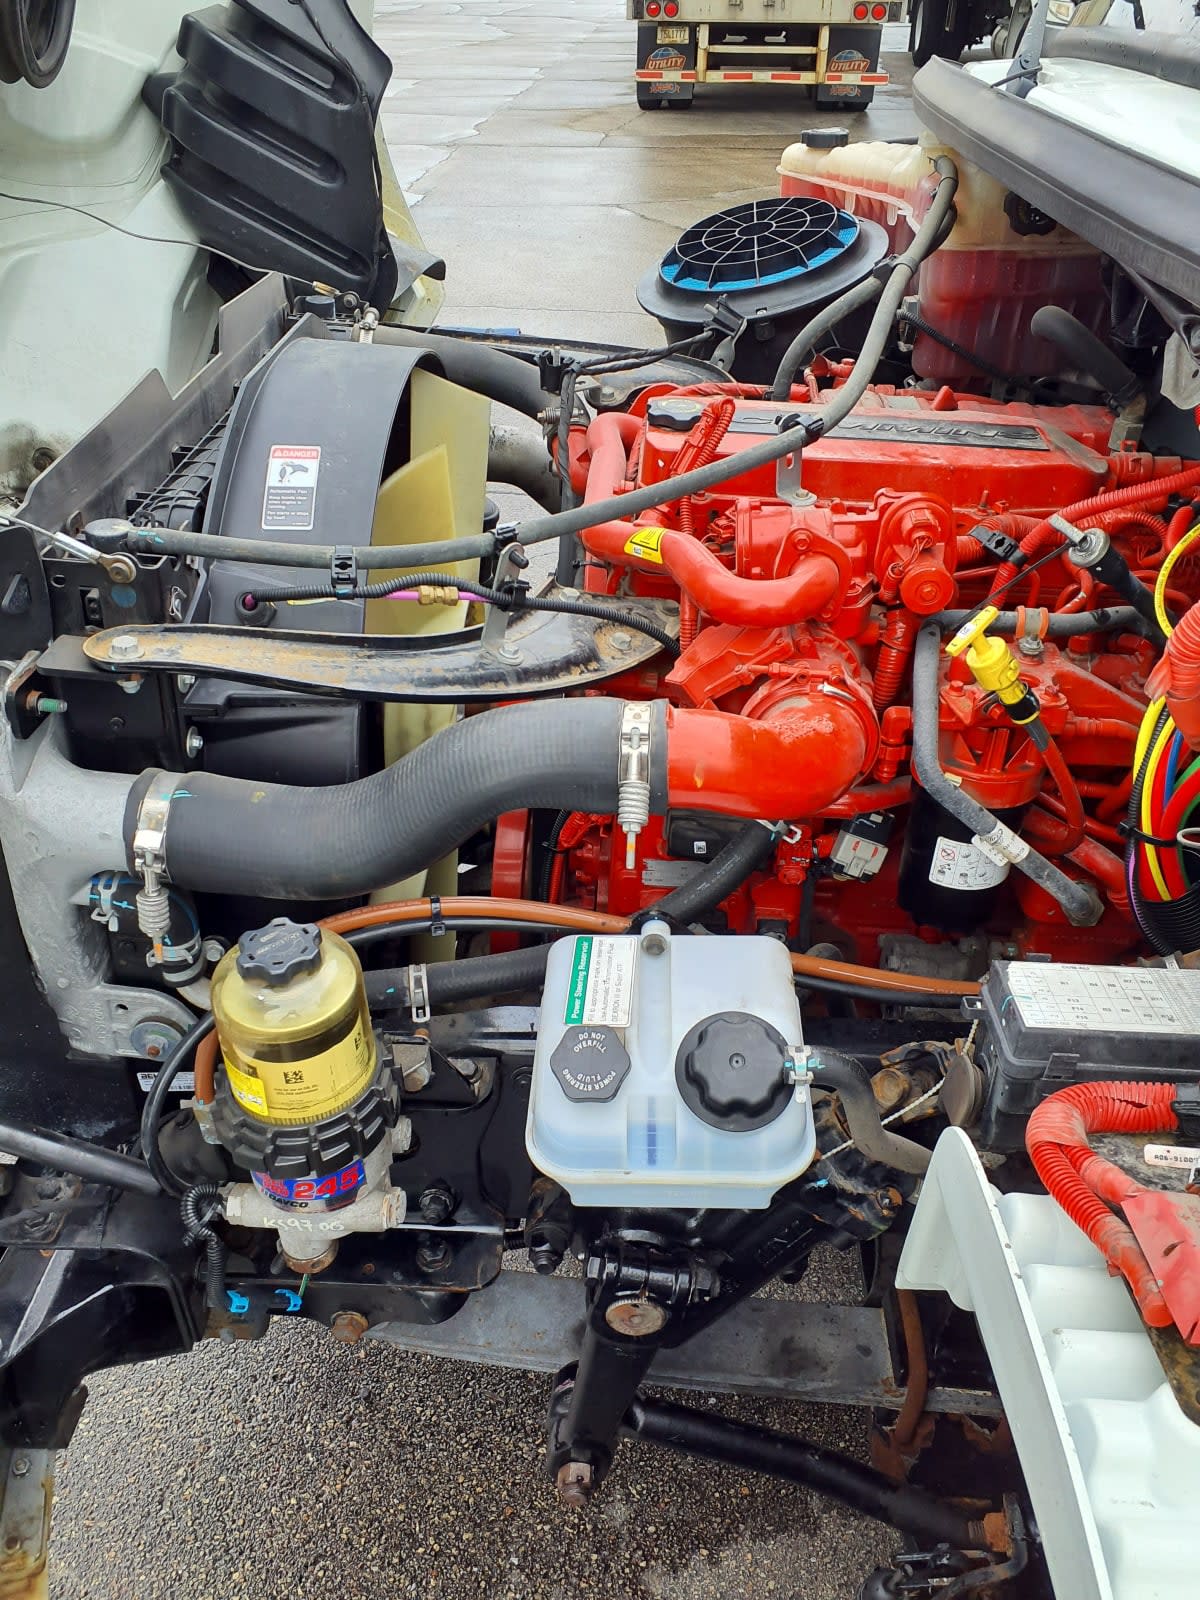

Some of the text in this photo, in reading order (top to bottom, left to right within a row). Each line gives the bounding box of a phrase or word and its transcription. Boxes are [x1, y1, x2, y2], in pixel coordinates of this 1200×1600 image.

[648, 58, 684, 69] UTILITY
[830, 61, 867, 71] UTILITY
[284, 450, 317, 458] DANGER
[571, 941, 589, 1019] Power Steering Reservoir
[578, 1032, 606, 1041] DO NOT
[573, 1040, 607, 1053] OVERFILL
[562, 1068, 616, 1092] POWER STEERING
[577, 1073, 602, 1082] FLUID
[293, 1166, 359, 1199] 245
[269, 1193, 309, 1208] DAVCO
